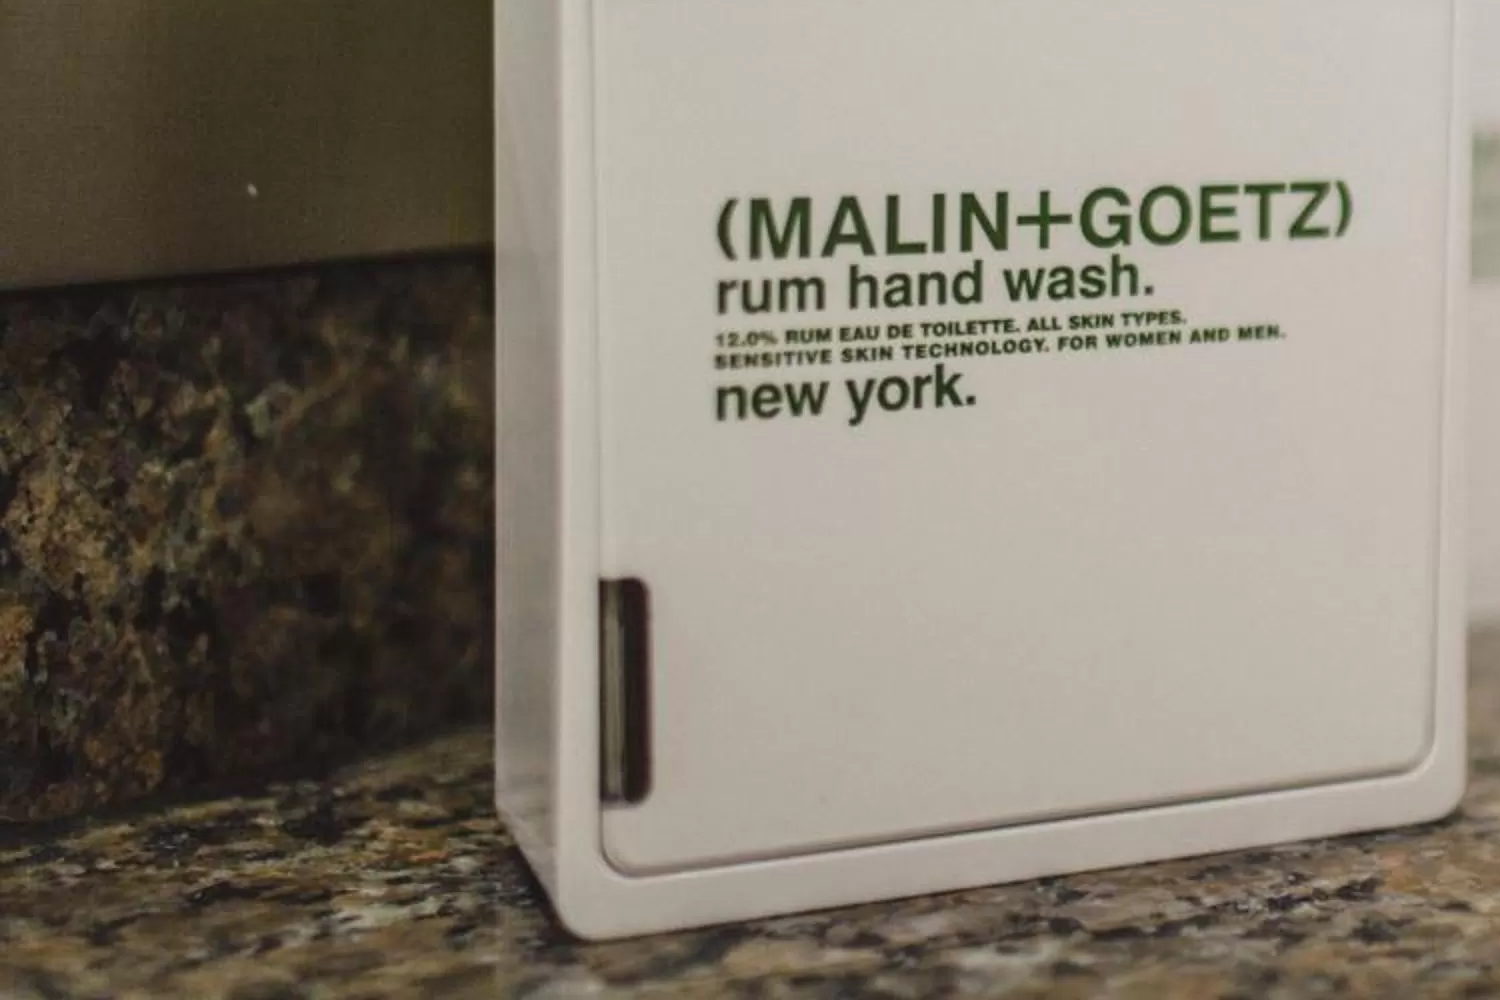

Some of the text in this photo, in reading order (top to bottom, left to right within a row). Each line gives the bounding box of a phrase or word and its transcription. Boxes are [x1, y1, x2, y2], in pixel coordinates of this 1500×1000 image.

[714, 179, 1353, 262] (MALIN+GOETZ)
[716, 253, 1155, 316] rum hand wash.
[713, 348, 834, 371] SENSITIVE
[840, 345, 894, 364] SKIN
[900, 337, 1050, 361] TECHNOLOGY.
[1057, 334, 1098, 352] FOR
[1104, 329, 1182, 349] WOMEN
[1189, 327, 1231, 345] AND
[784, 327, 833, 345] RUM
[838, 325, 881, 343] EAU
[886, 323, 914, 341] DE
[920, 317, 1021, 339] TOILETTE.
[1026, 315, 1063, 333] ALL
[1067, 312, 1115, 331] SKIN
[1119, 309, 1187, 328] TYPES.
[715, 362, 978, 427] new york.
